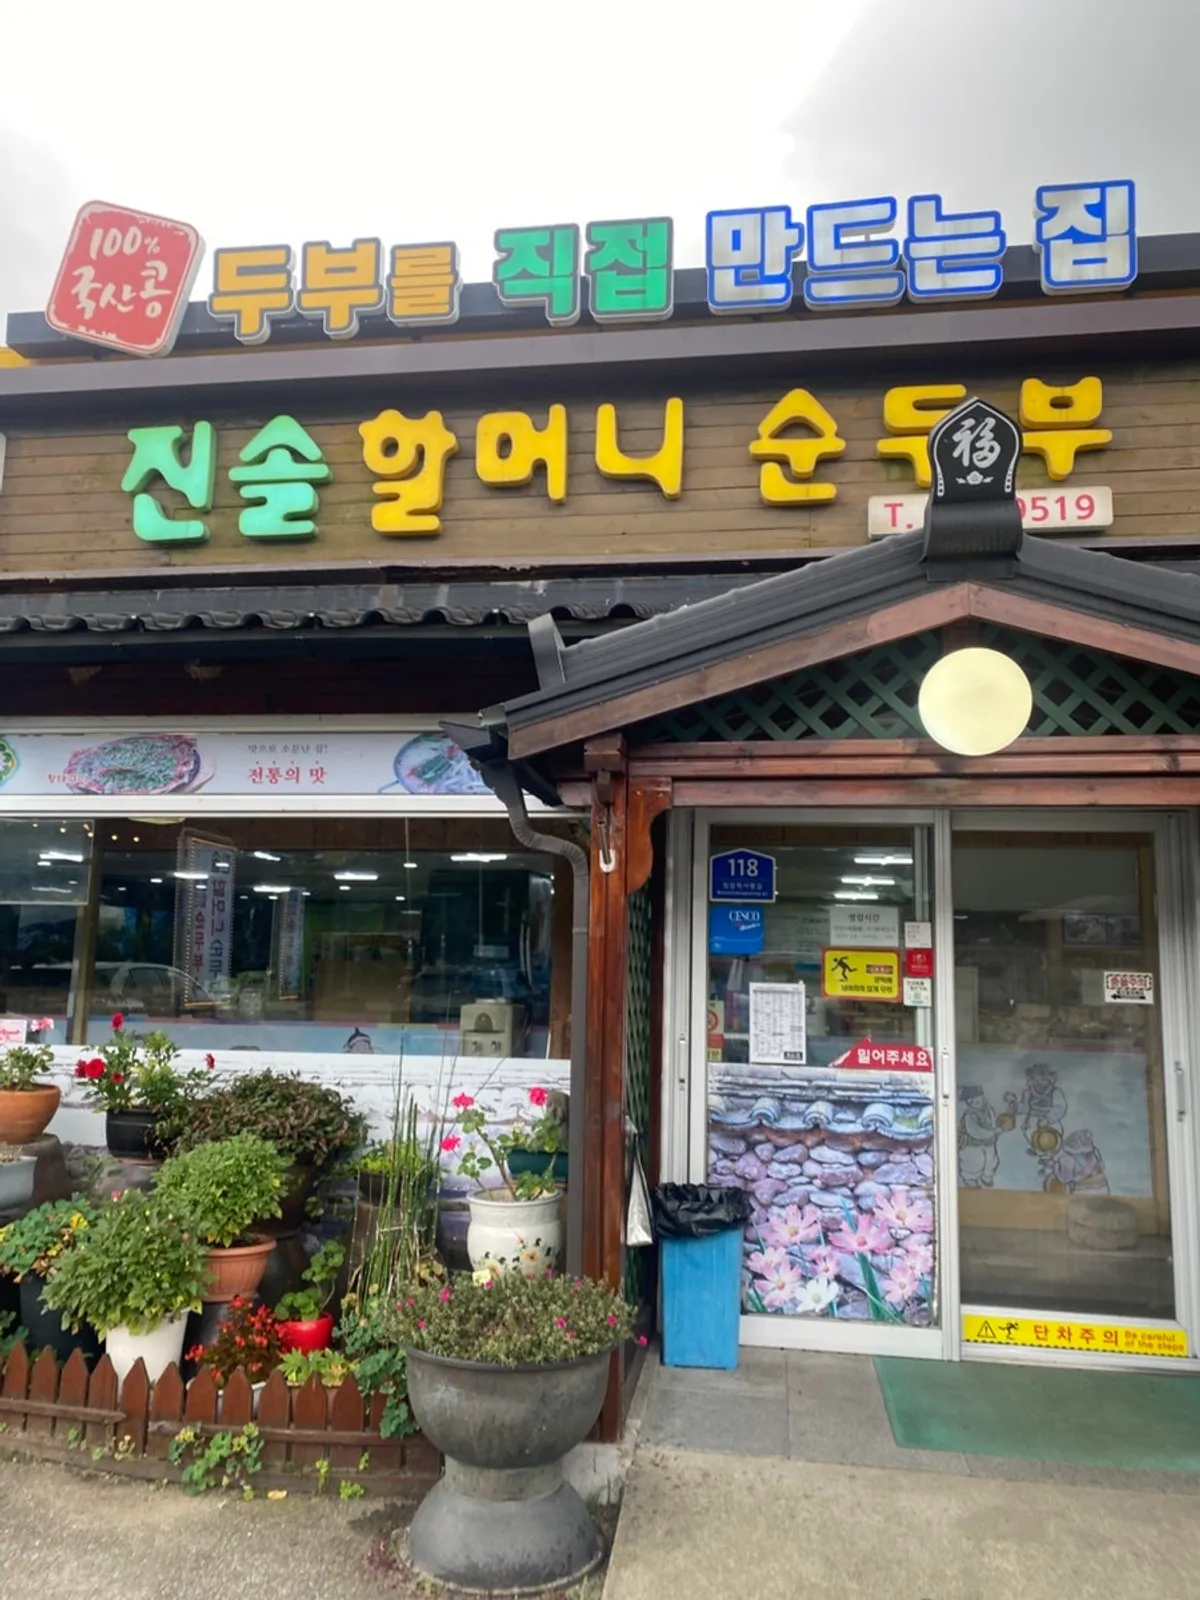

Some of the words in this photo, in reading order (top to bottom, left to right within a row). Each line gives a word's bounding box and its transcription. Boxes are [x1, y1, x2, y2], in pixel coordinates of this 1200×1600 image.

[89, 226, 160, 261] 100%
[207, 236, 461, 344] 두부를
[494, 217, 674, 325] 직접
[706, 193, 1007, 313] 만드는
[1036, 179, 1137, 296] 집
[71, 260, 172, 320] 국산콩
[952, 417, 1001, 469] 福
[121, 415, 332, 543] 진솔
[358, 397, 684, 535] 할머니
[749, 376, 1112, 507] 순두부
[884, 502, 913, 530] T.
[249, 767, 300, 784] 전통의
[309, 767, 327, 784] 맛
[728, 858, 759, 877] 118
[858, 1049, 929, 1066] 밀어주세요
[1125, 1331, 1138, 1339] Be
[1141, 1332, 1175, 1342] careful
